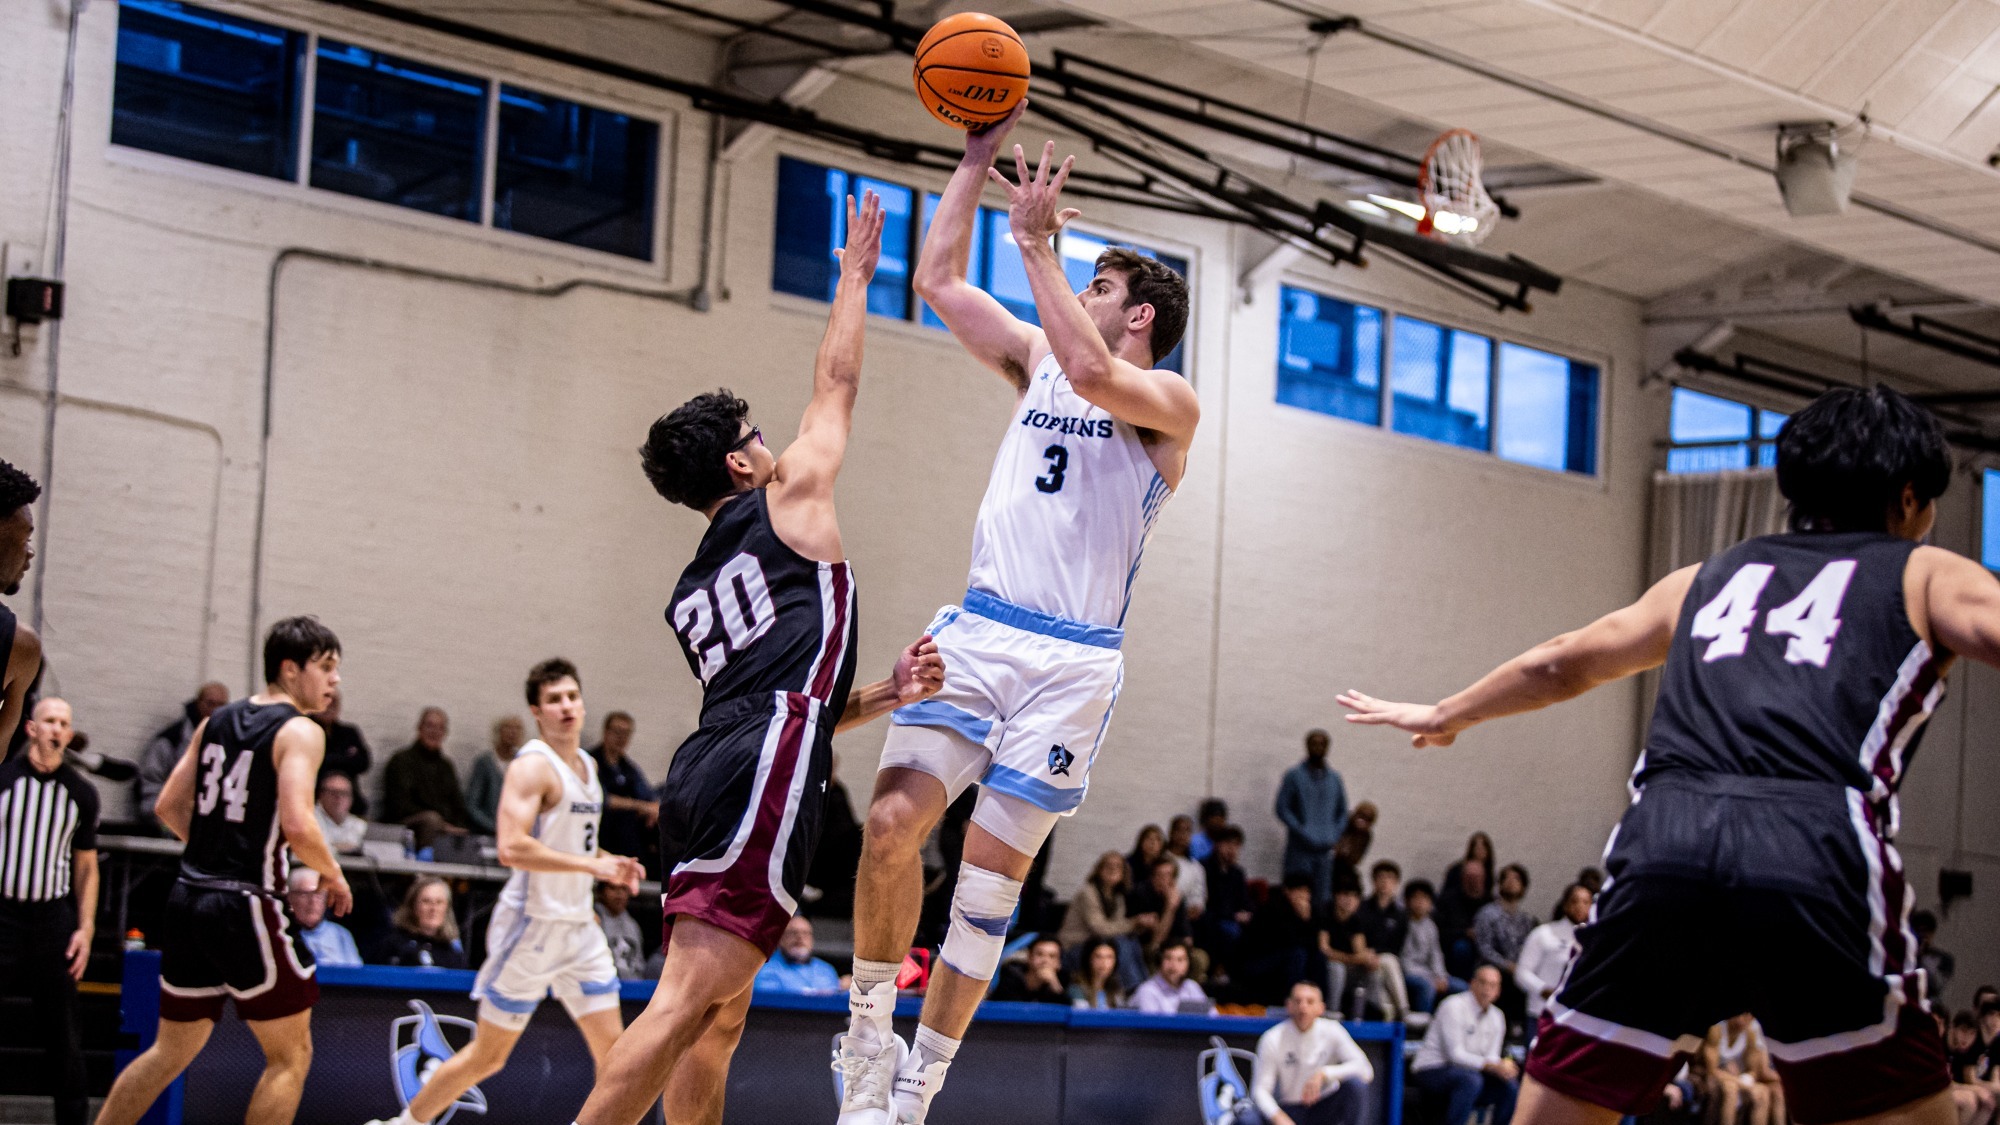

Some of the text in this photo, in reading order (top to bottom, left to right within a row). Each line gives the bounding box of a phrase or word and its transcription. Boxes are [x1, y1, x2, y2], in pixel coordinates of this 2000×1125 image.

[936, 104, 990, 131] ilson
[963, 85, 1010, 103] EVO
[1035, 443, 1069, 494] 3
[673, 552, 777, 687] 20
[1690, 559, 1858, 668] 44
[198, 742, 255, 823] 34
[584, 821, 594, 852] 2
